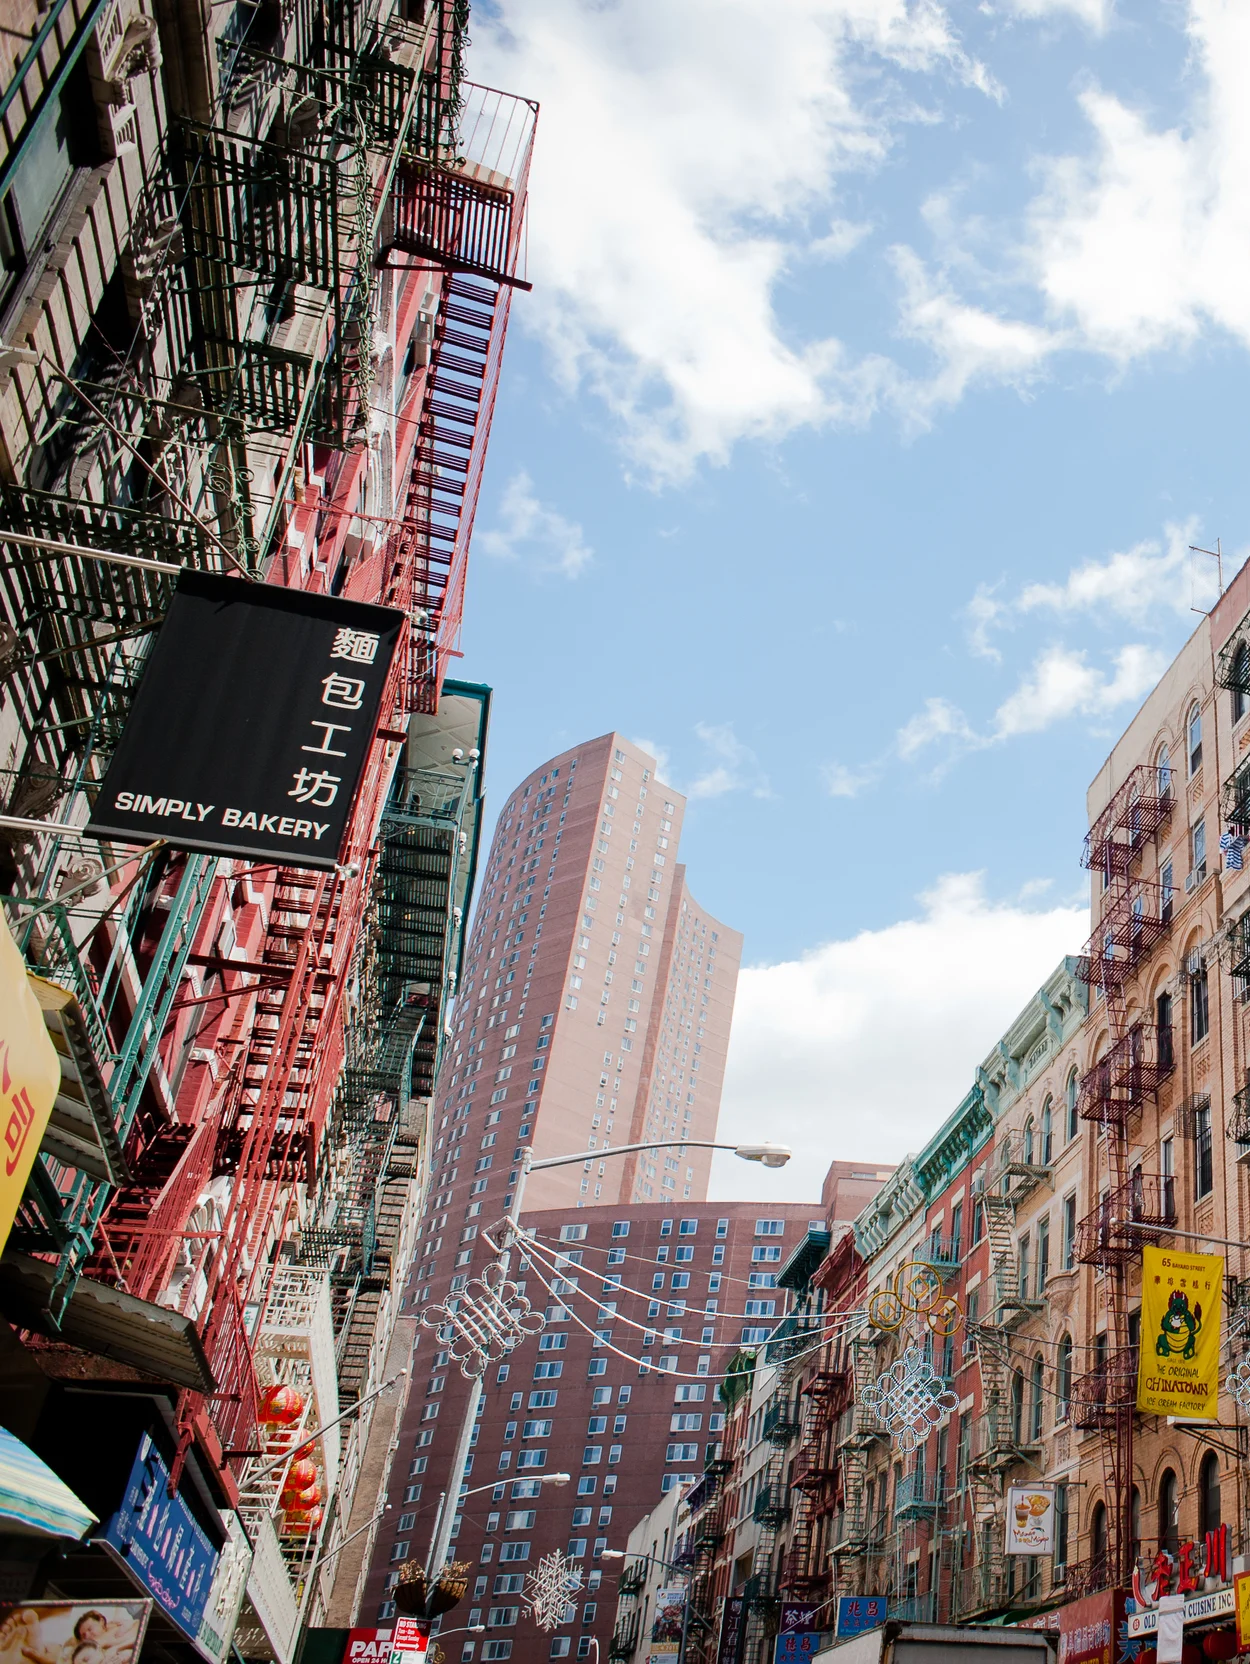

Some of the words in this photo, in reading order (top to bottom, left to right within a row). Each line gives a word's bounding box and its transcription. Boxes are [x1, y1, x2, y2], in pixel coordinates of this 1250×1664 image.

[288, 627, 380, 807] 麵包工坊
[114, 792, 214, 823] SIMPLY
[221, 808, 331, 841] BAKERY
[1162, 1258, 1172, 1268] 65
[1172, 1262, 1190, 1271] BAYARD
[1190, 1263, 1206, 1272] STREET
[1156, 1364, 1166, 1375] THE
[1168, 1365, 1200, 1378] ORIGINAL
[1145, 1377, 1208, 1396] CHINATOWN
[1146, 1397, 1156, 1406] ICE
[1158, 1397, 1178, 1408] CREAM
[1179, 1399, 1207, 1411] FACTORY
[1144, 1614, 1157, 1629] OLD
[1188, 1597, 1217, 1618] CUISINE
[1218, 1591, 1234, 1607] INC.
[350, 1641, 393, 1658] PAR
